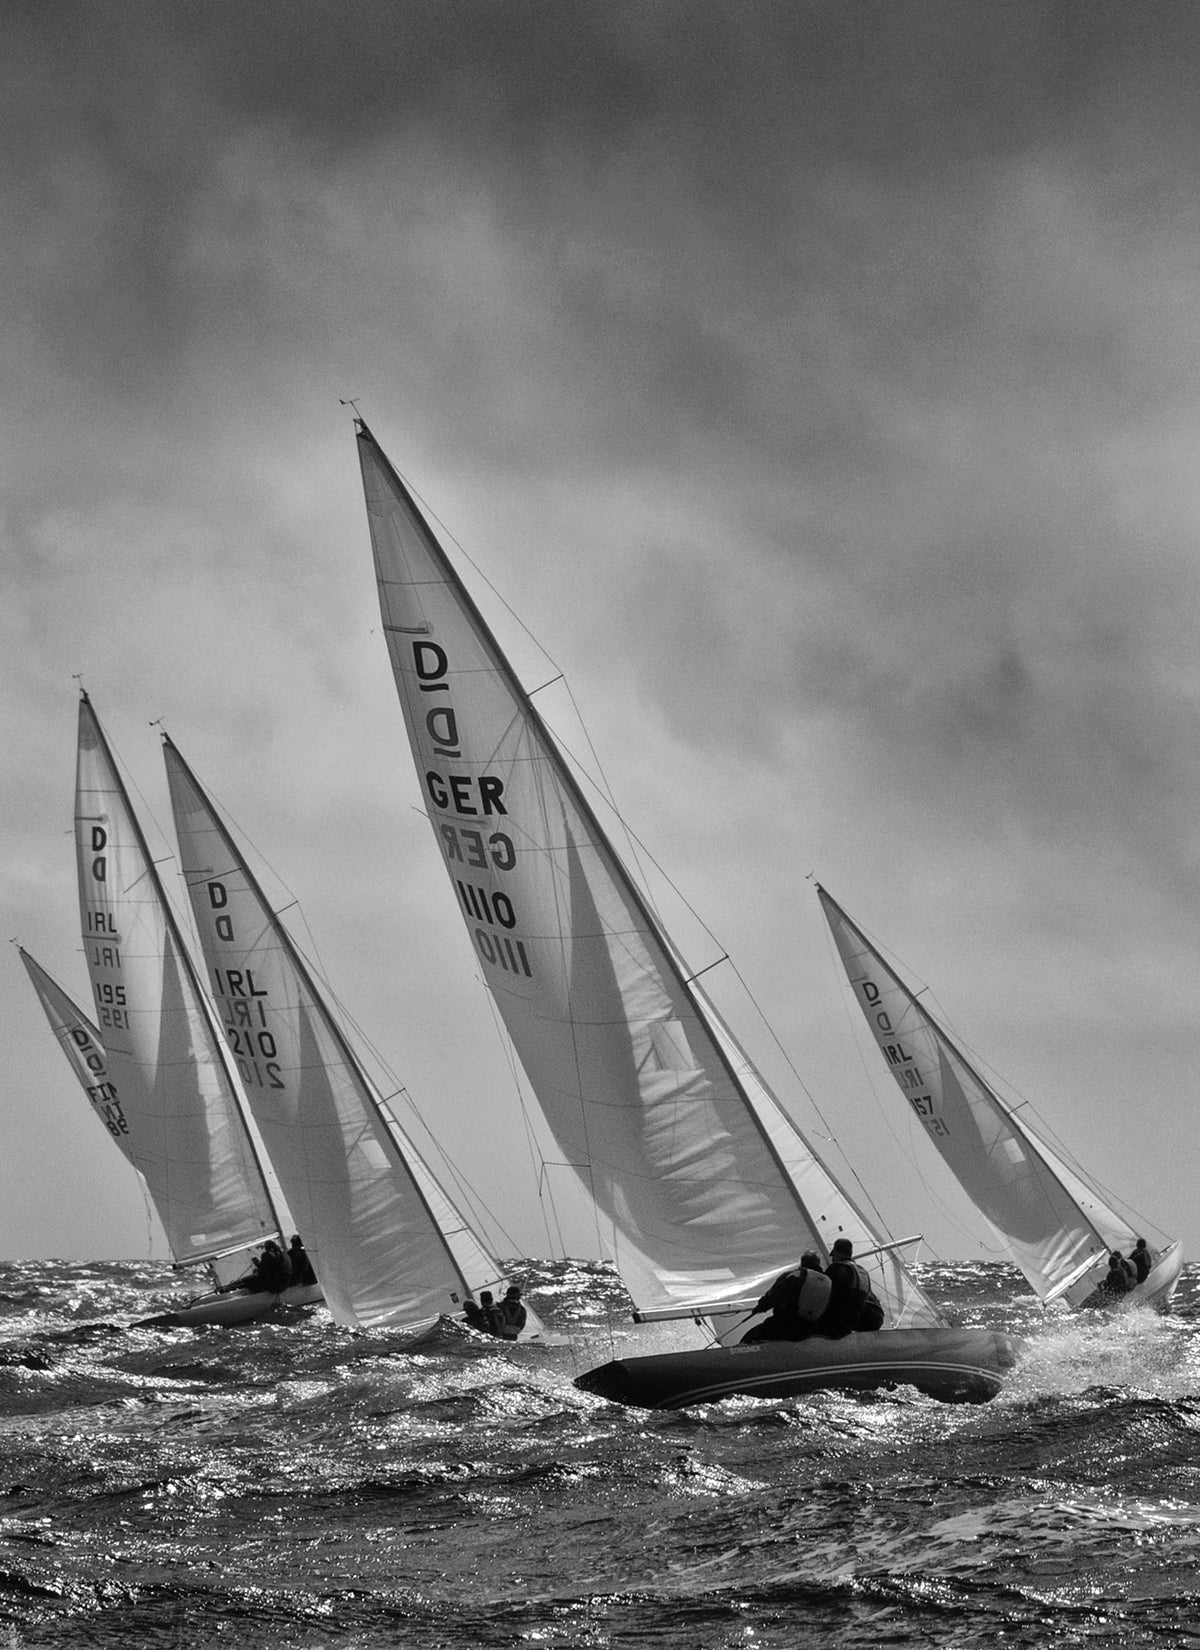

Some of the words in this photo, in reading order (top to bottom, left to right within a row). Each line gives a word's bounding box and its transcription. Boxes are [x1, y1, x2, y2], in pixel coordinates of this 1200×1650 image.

[412, 641, 448, 680] D
[426, 771, 508, 815] GER
[92, 827, 107, 851] D
[208, 882, 228, 909] D
[88, 912, 117, 933] IRL
[96, 983, 126, 1006] 195
[215, 968, 268, 997] IRL
[862, 982, 879, 1001] D
[72, 1029, 89, 1046] D
[228, 1028, 277, 1059] 210
[882, 1043, 913, 1065] IRL
